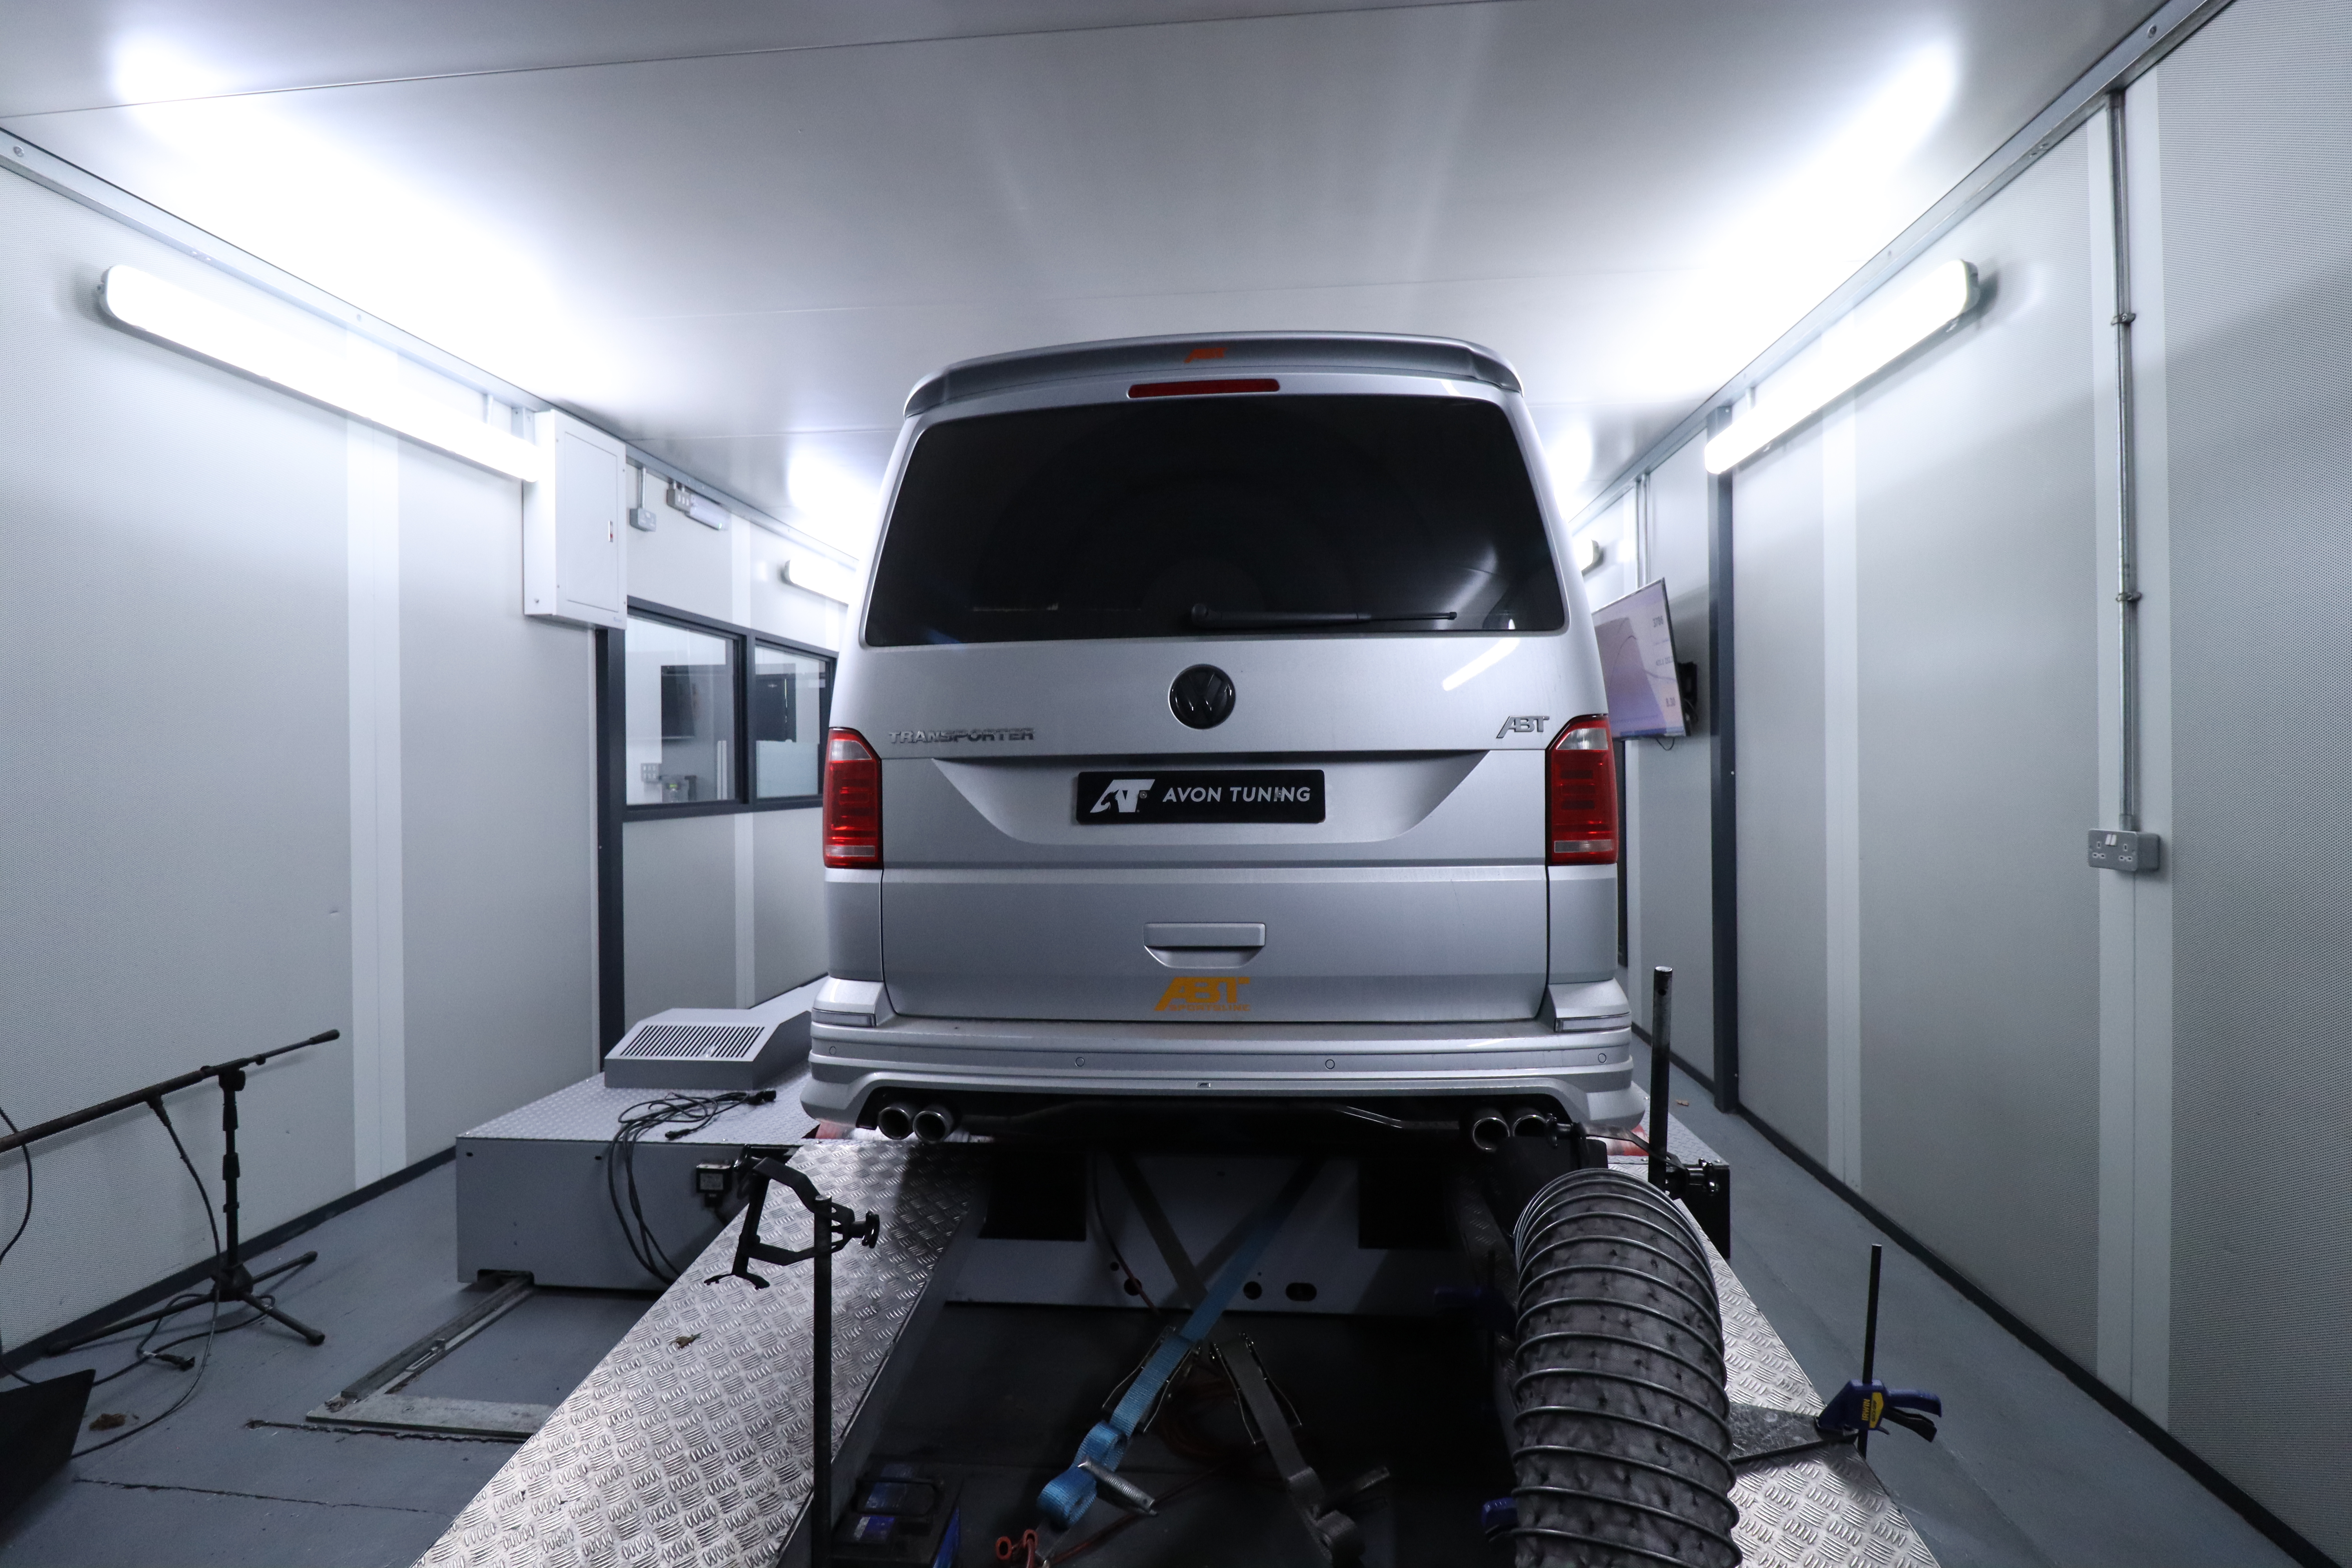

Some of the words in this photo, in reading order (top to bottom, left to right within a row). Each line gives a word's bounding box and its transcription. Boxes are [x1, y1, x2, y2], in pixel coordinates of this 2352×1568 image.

[889, 728, 1035, 744] TRANSPORTER
[1496, 716, 1550, 739] ABT
[1163, 787, 1221, 802] AVON
[1230, 787, 1310, 802] TUNING
[1154, 977, 1250, 1011] ABT
[1862, 1399, 1870, 1421] IRWIN
